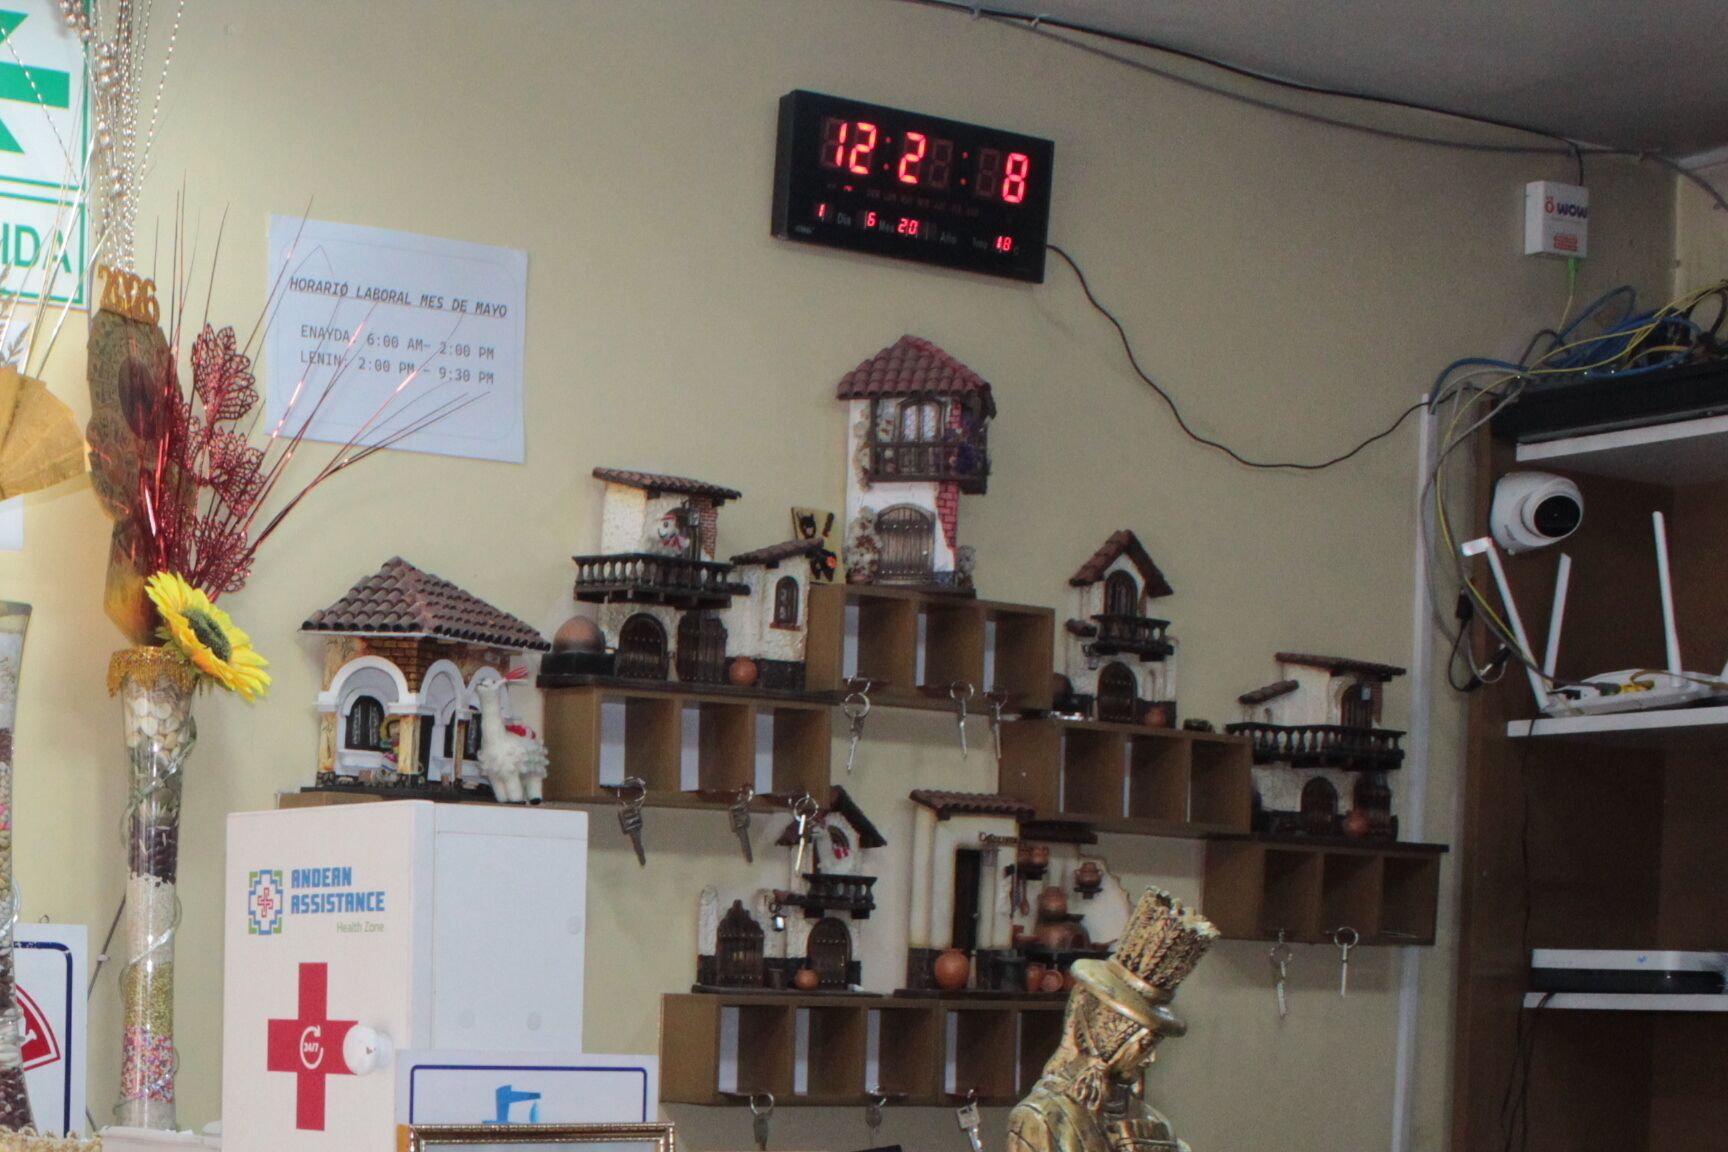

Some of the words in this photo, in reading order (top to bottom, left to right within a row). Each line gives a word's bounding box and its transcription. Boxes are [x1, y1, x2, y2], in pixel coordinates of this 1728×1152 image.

[289, 276, 348, 297] HORARIO
[356, 287, 411, 306] LABORAL
[421, 294, 444, 310] MES
[452, 298, 467, 313] DE
[475, 302, 507, 318] MAYO
[367, 333, 399, 349] 6:00
[439, 342, 471, 357] 2:00
[479, 346, 495, 360] PM
[358, 357, 390, 373] 2:00
[399, 362, 415, 376] PM
[439, 366, 471, 382] 9:30
[479, 371, 495, 385] PM
[291, 867, 352, 888] ANDEAN
[291, 891, 385, 914] ASSISTANCE
[336, 921, 363, 933] Health
[364, 921, 384, 933] Zone
